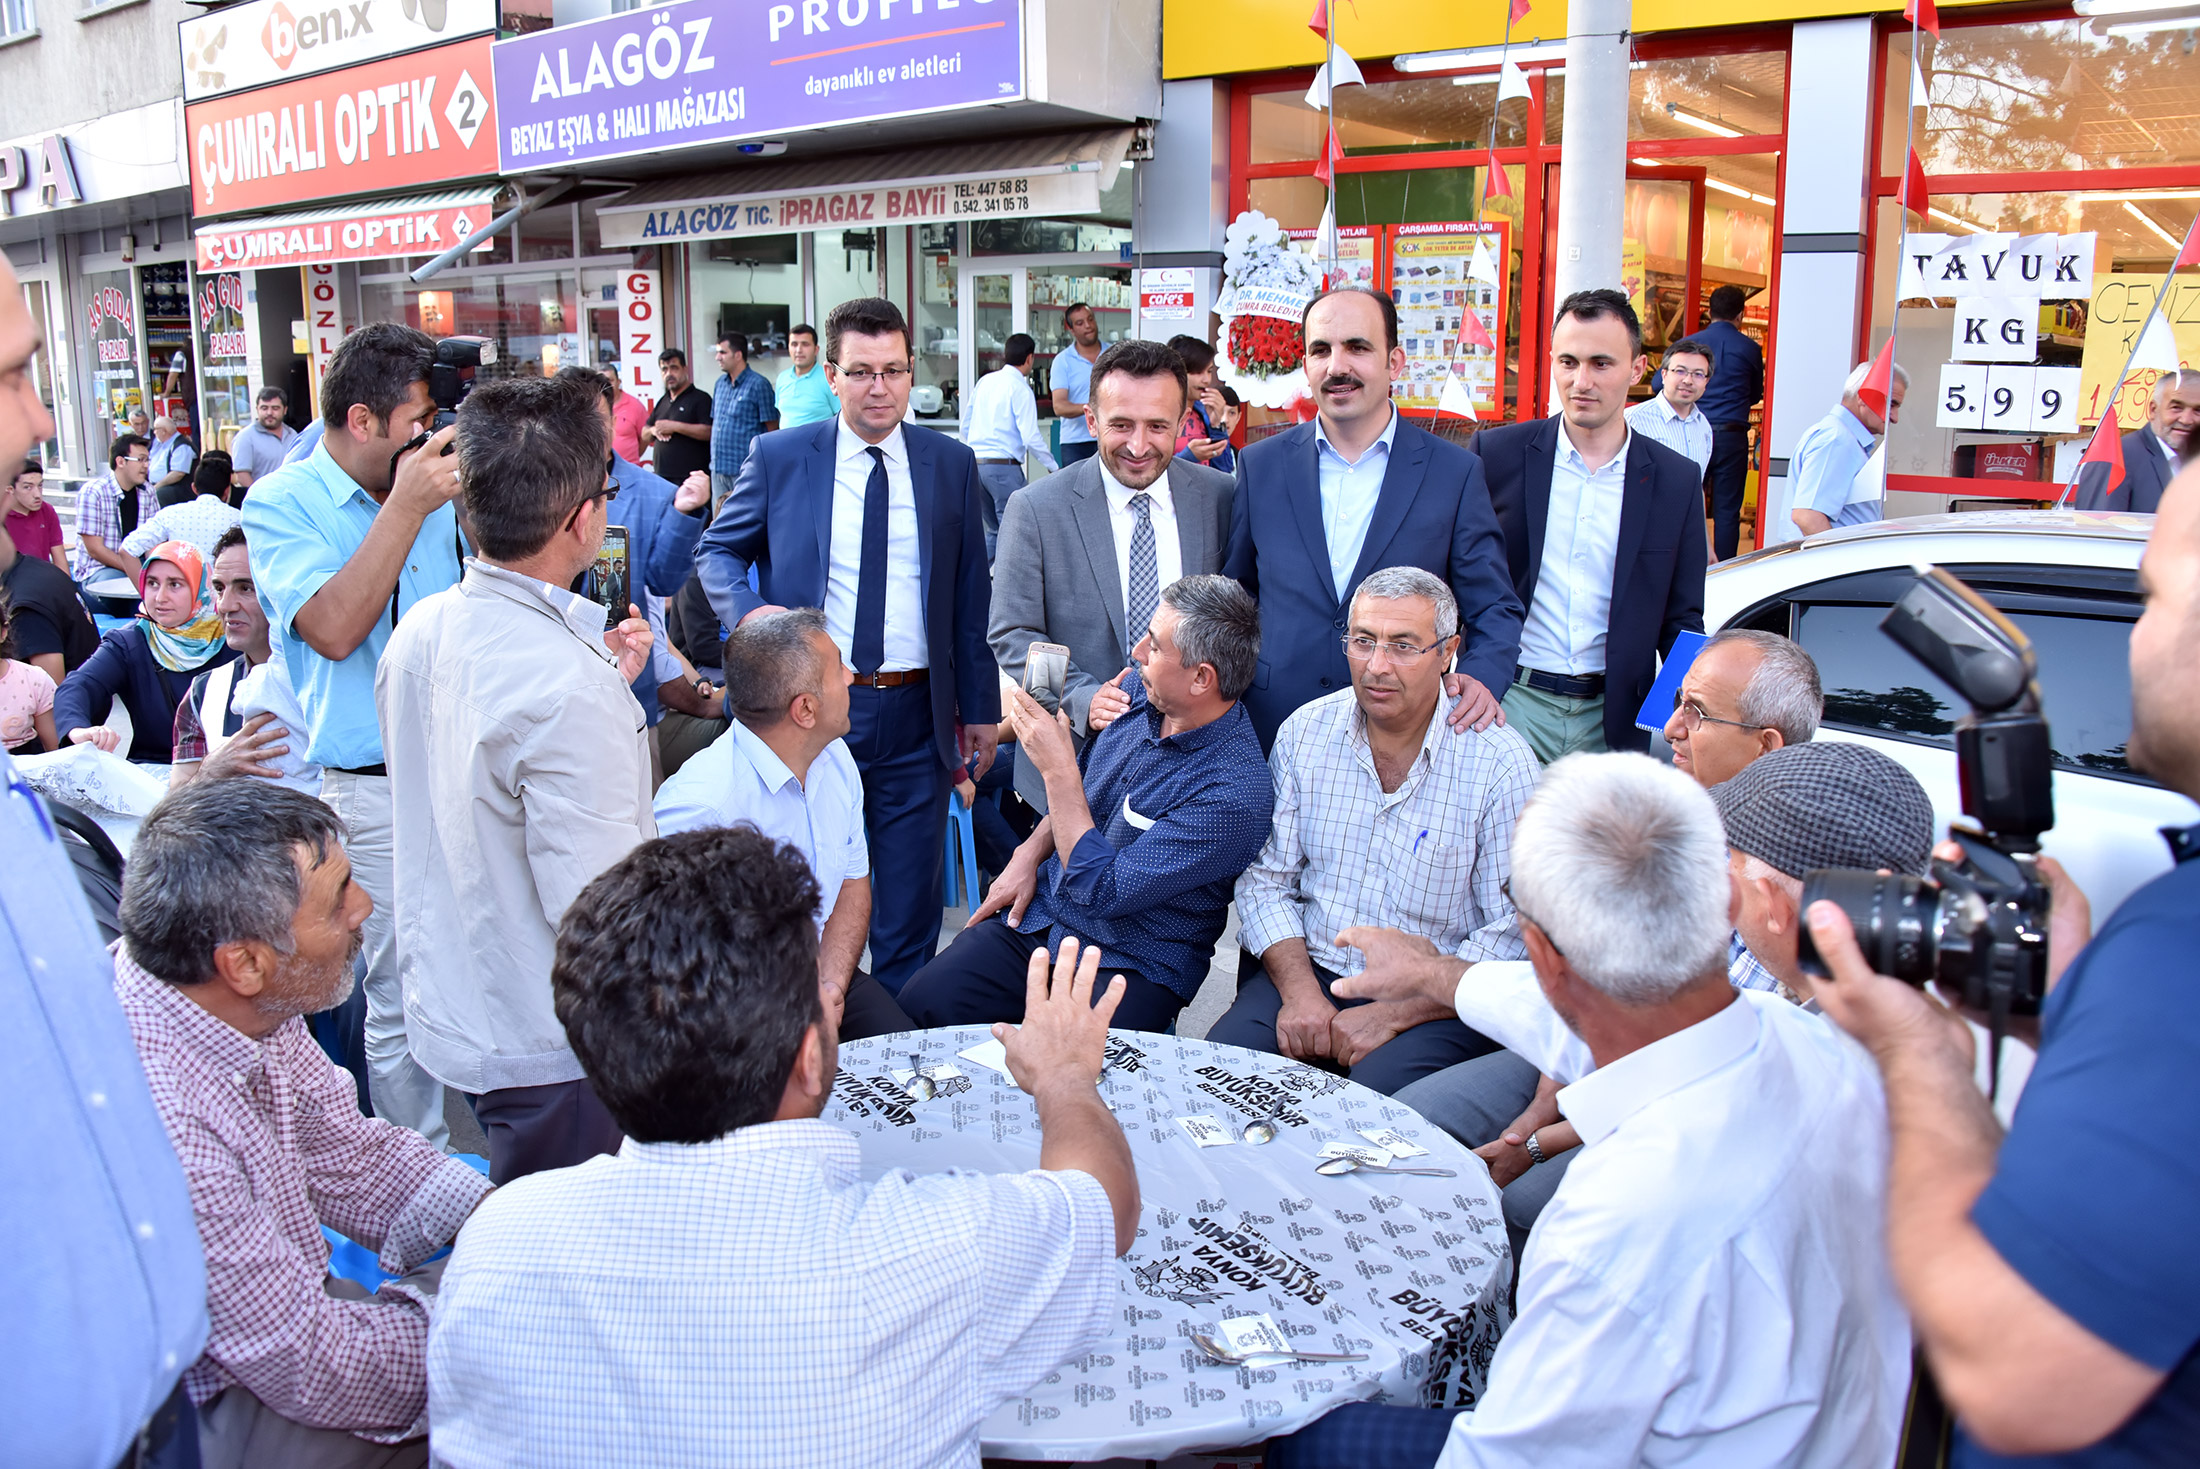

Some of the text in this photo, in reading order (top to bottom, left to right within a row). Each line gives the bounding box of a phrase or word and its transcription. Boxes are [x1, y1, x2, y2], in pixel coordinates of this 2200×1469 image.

[530, 11, 716, 104] ALAGÖZ
[804, 52, 962, 97] dayanıklı ev aletleri
[510, 86, 746, 157] BEYAZ EŞYA & HALI MAĞAZASI
[197, 100, 326, 206] ÇUMRALI
[458, 90, 477, 130] 2
[641, 203, 740, 238] ALAGÖZ
[954, 184, 975, 198] TEL:
[977, 182, 997, 196] 447
[999, 180, 1012, 195] 58
[1014, 179, 1028, 193] 83
[953, 196, 1029, 214] 0.542. 341 05 78
[206, 225, 333, 268] ÇUMRALI
[458, 218, 468, 235] 2
[1398, 224, 1445, 235] ÇARŞAMBA
[1912, 249, 2082, 283] TAVUK
[102, 286, 133, 336] GIDA
[199, 279, 217, 333] AS
[1235, 302, 1260, 313] ÇUMRA
[1238, 289, 1306, 309] DR. MEHME
[98, 338, 130, 363] PAZARI
[1963, 318, 2025, 345] KG
[1243, 1074, 1303, 1106] KONYA
[1192, 1244, 1268, 1292] KONYA
